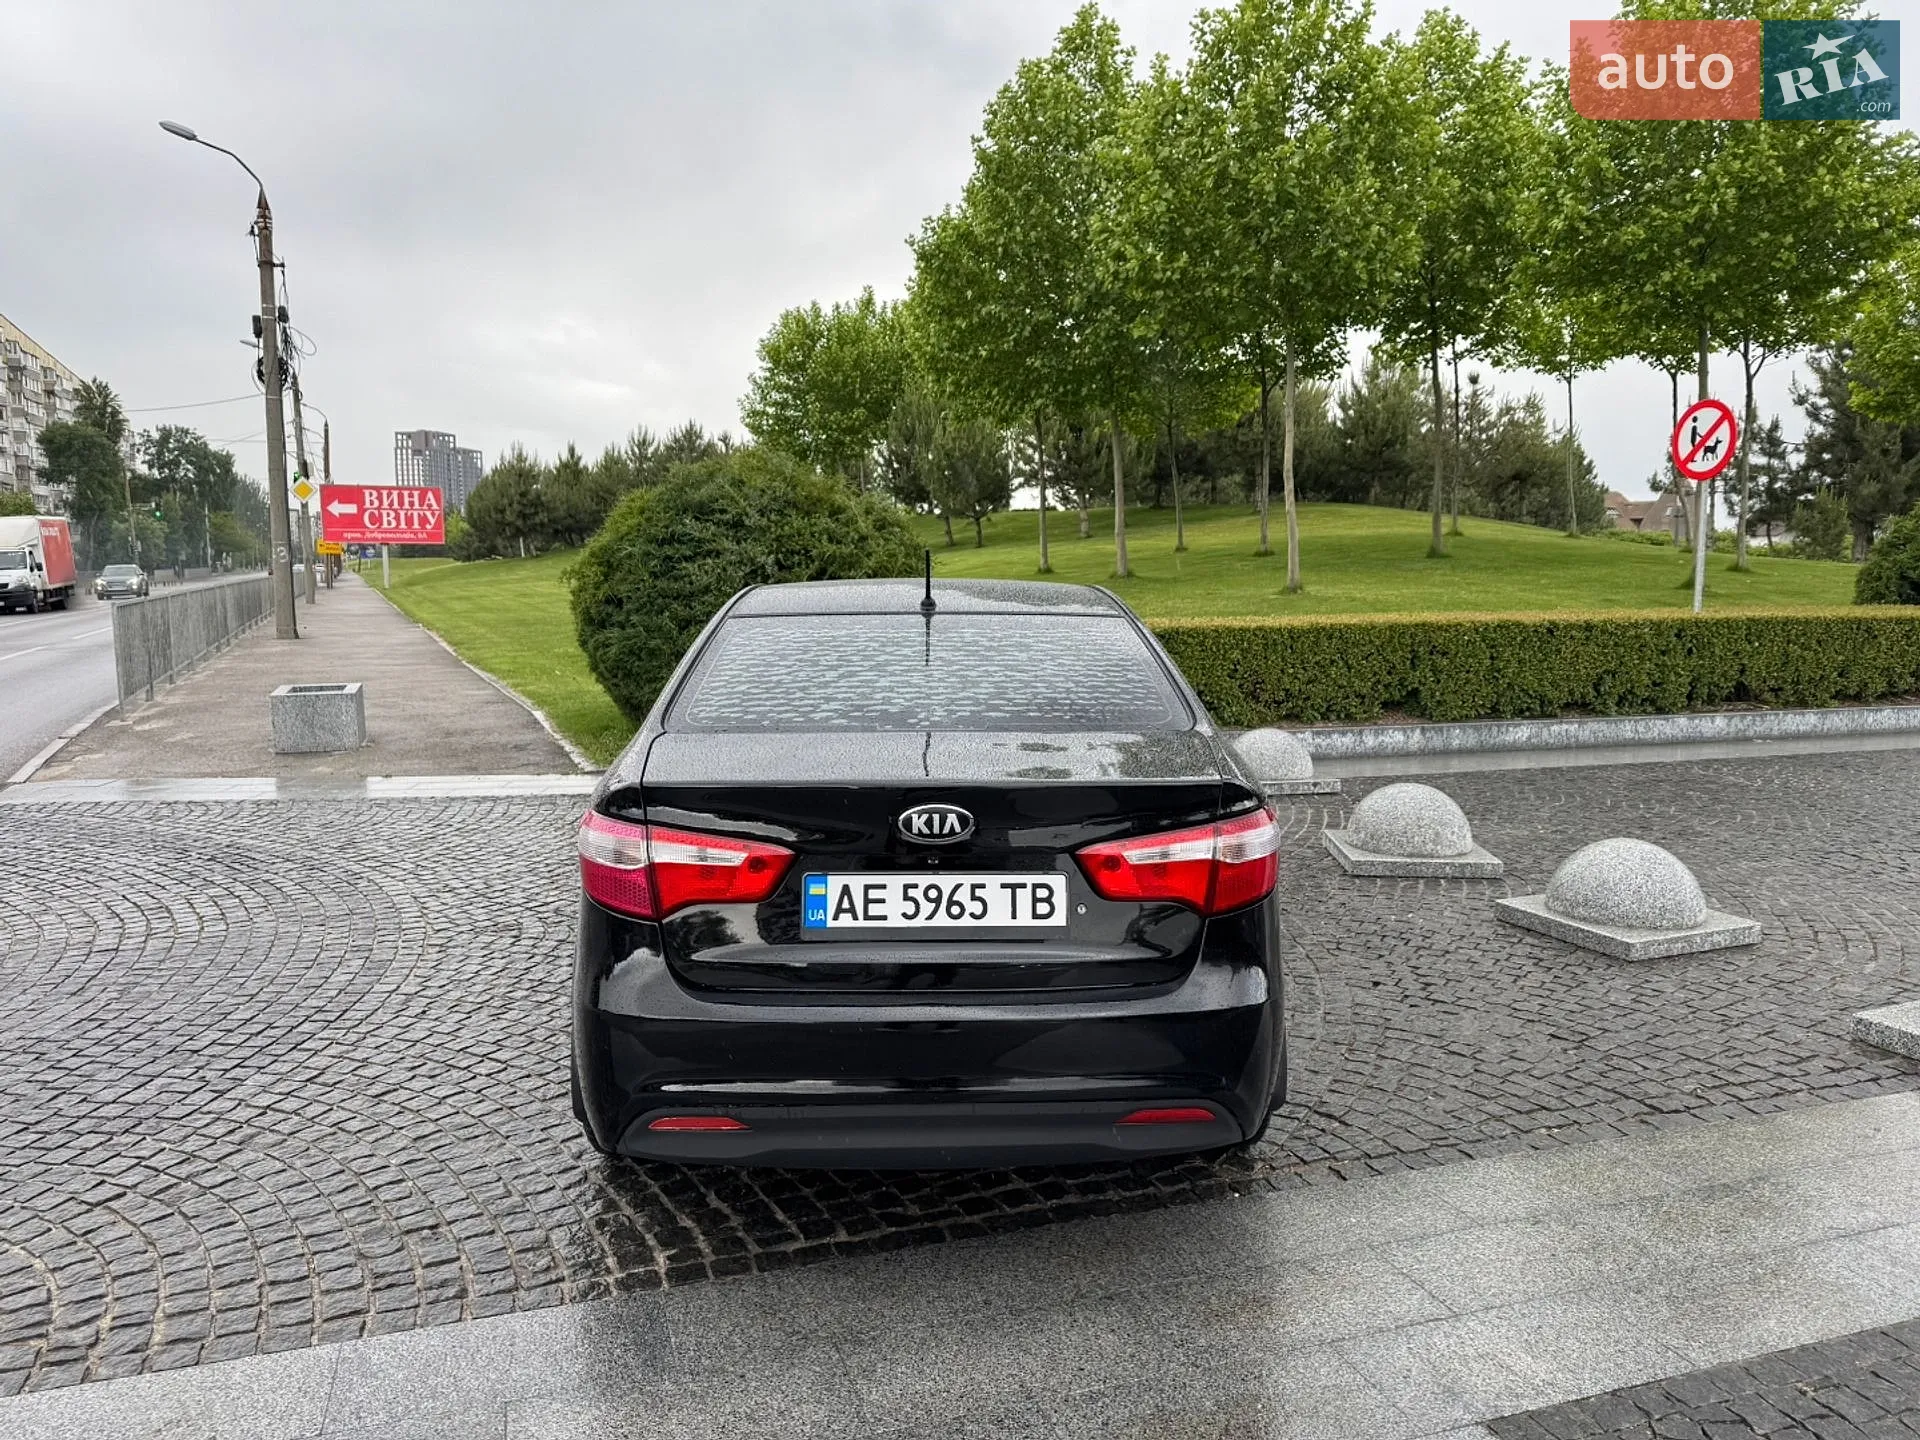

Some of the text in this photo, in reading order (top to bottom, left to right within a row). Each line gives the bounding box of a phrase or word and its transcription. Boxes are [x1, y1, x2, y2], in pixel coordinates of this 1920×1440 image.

[362, 489, 440, 510] ВИНА
[363, 509, 441, 530] СВІТУ
[911, 813, 962, 834] KIA
[832, 882, 1056, 921] AE 5965 TB
[808, 909, 826, 921] UA
